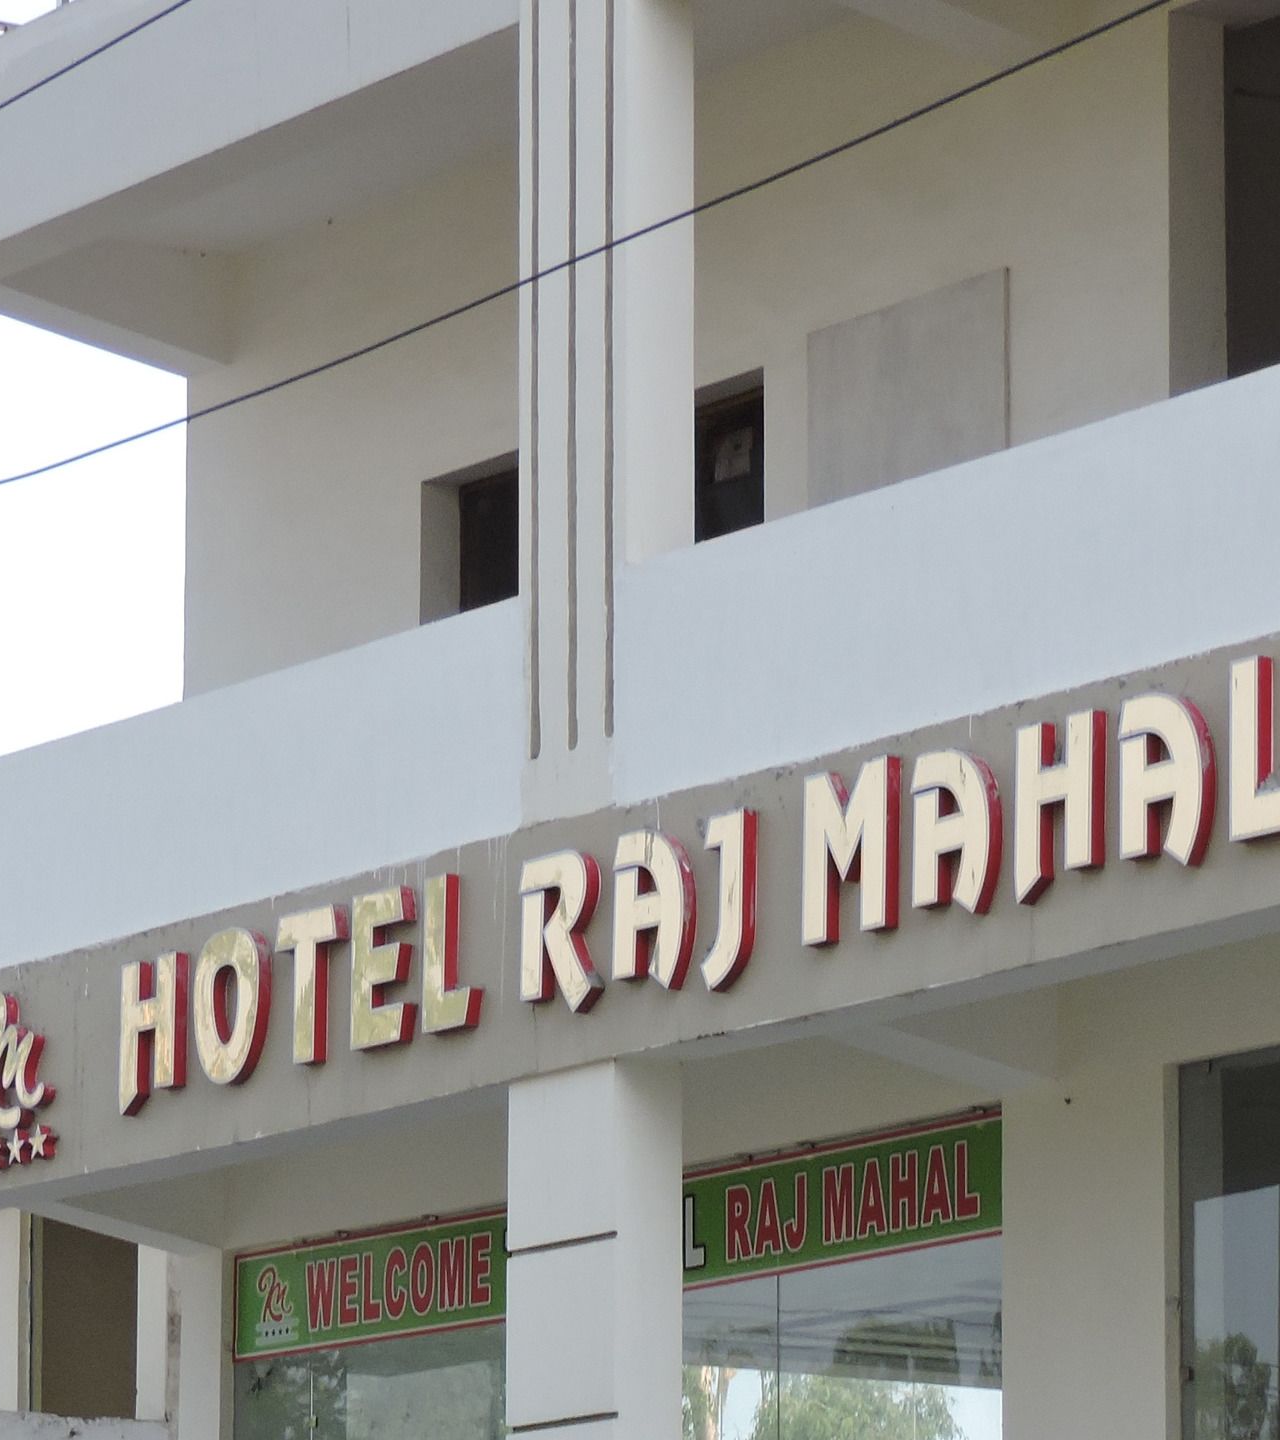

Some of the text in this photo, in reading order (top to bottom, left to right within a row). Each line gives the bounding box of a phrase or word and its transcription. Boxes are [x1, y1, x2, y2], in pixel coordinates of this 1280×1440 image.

[118, 873, 485, 1117] HOTEL
[519, 806, 758, 1014] RAJ
[305, 1231, 493, 1333] WELCOME
[725, 1171, 808, 1263] RAJ
[822, 1140, 980, 1246] MAHAL
